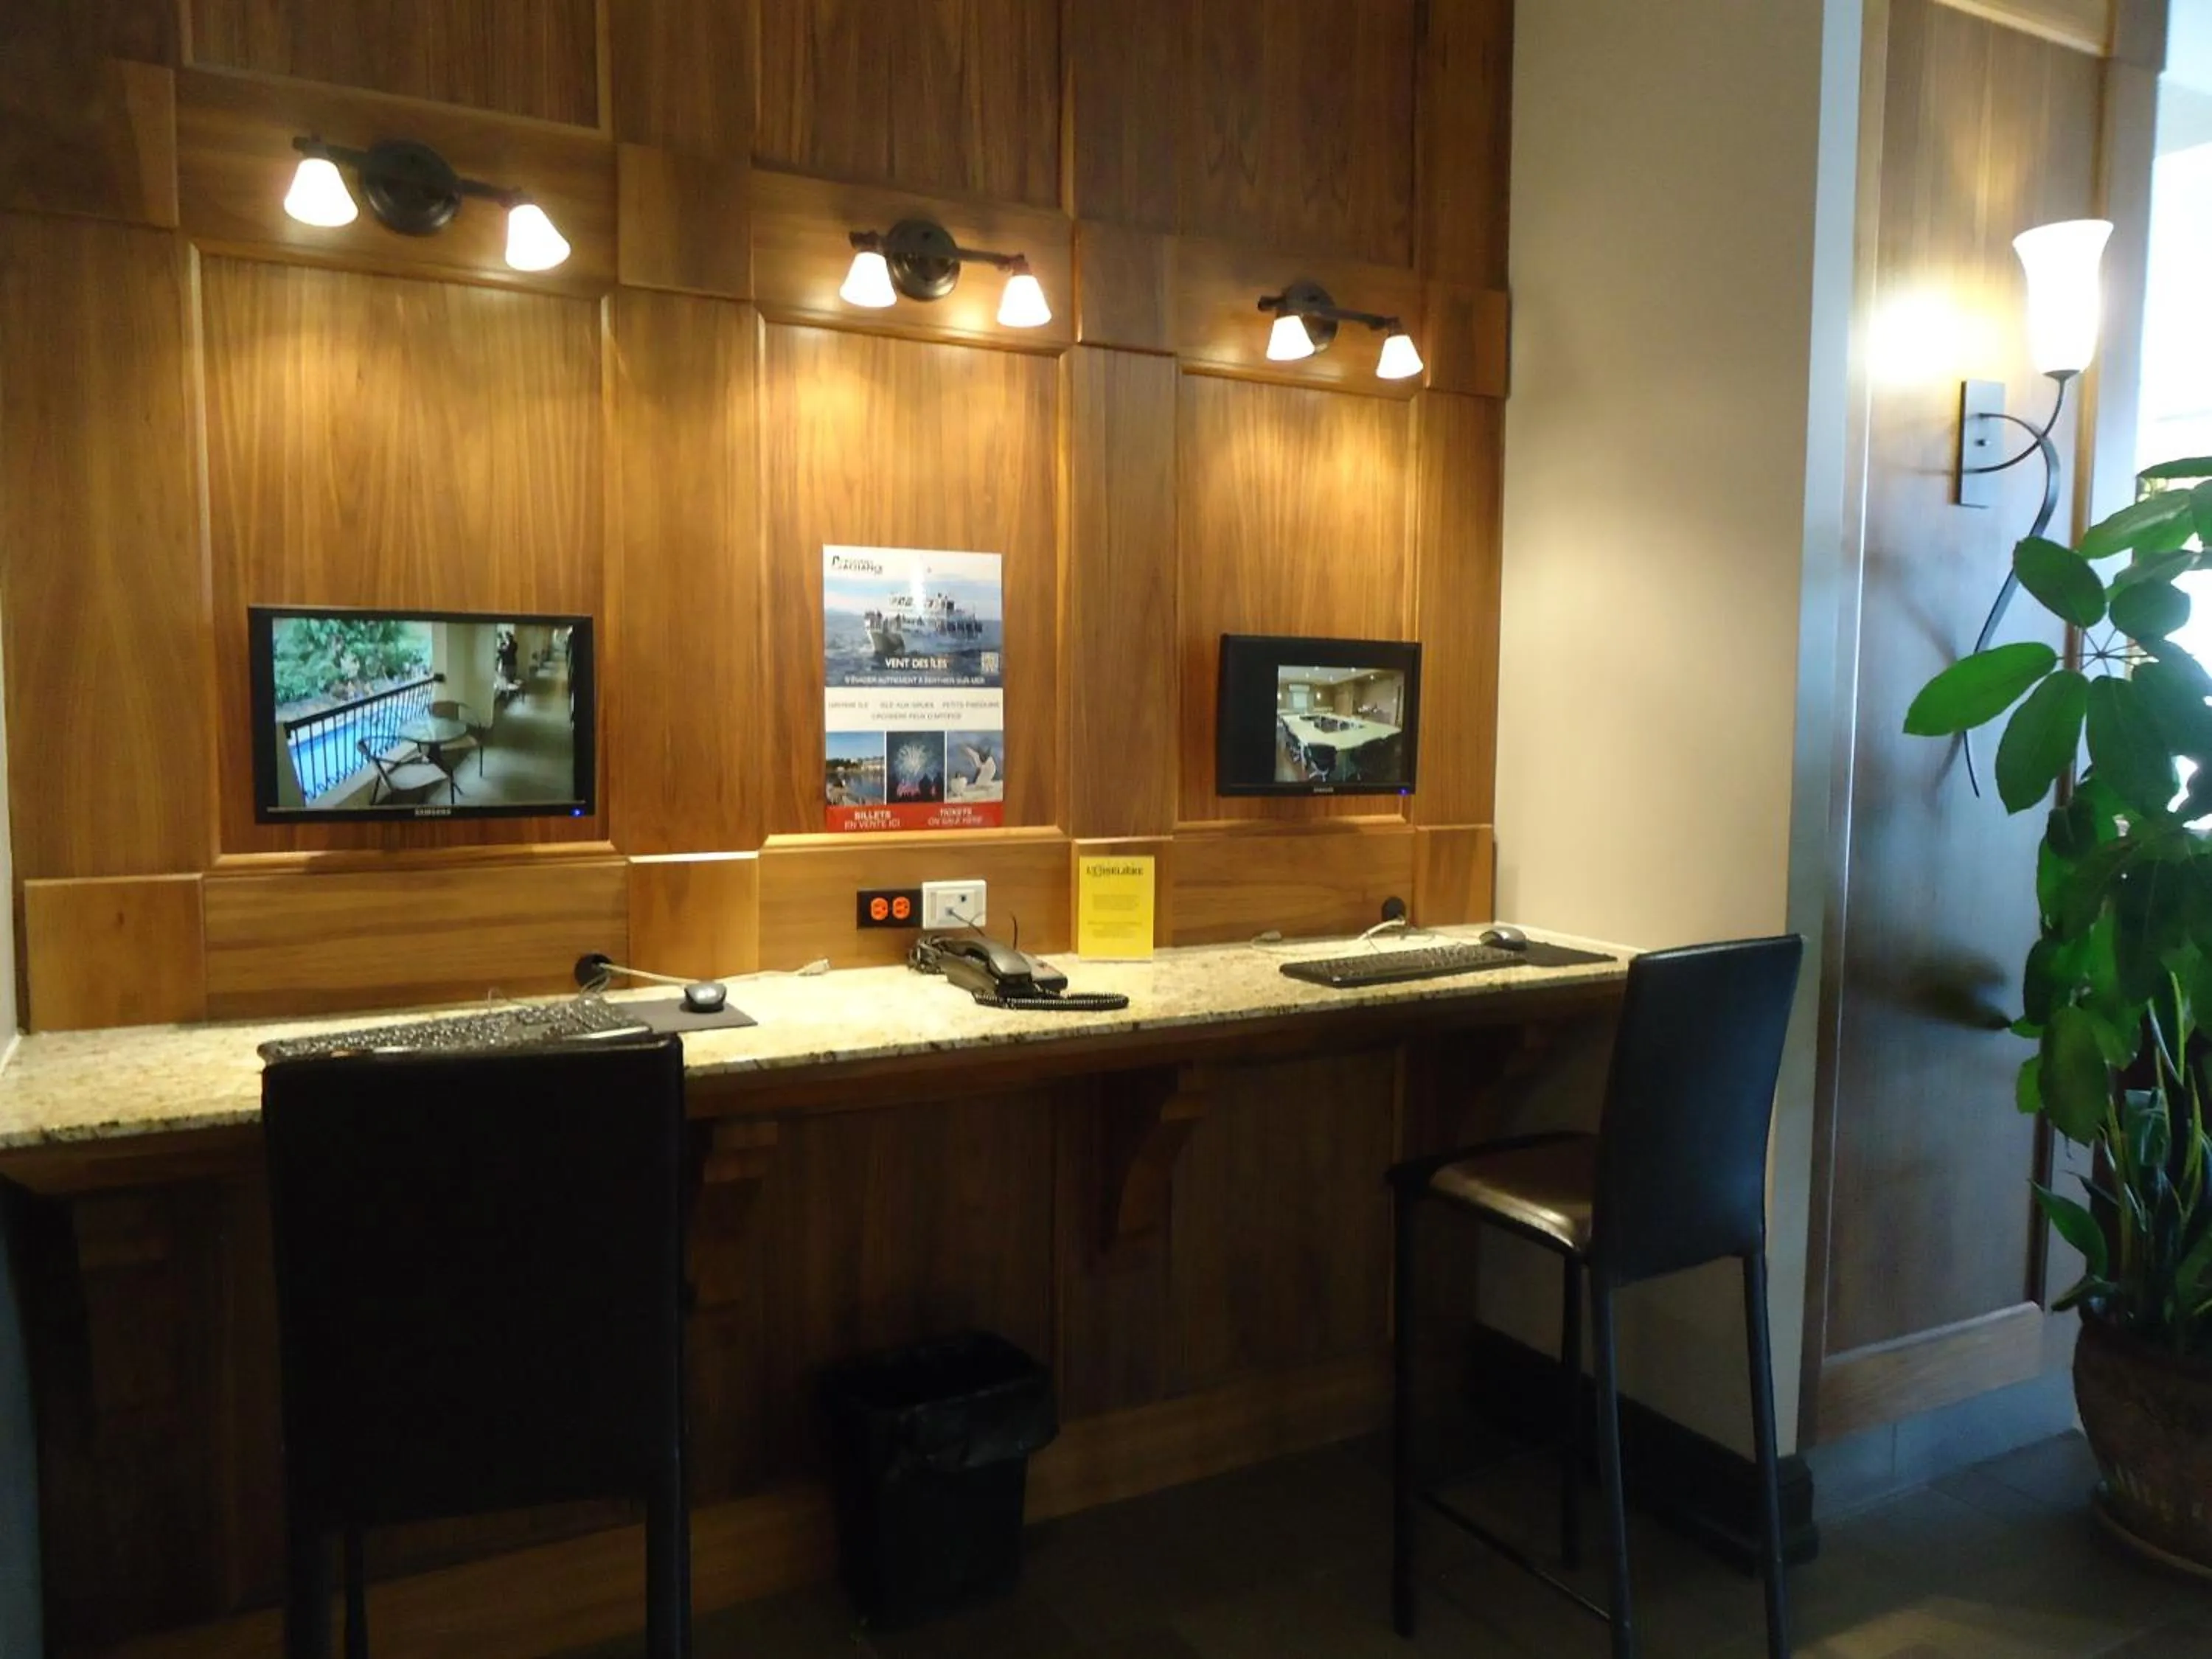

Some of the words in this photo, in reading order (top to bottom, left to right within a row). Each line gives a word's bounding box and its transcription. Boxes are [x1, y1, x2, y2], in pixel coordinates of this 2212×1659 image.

[885, 657, 910, 669] VENT
[912, 657, 929, 669] DES
[855, 810, 891, 820] BILLETS
[844, 820, 857, 830] EN
[858, 819, 887, 830] VENTE
[888, 818, 901, 828] ICI
